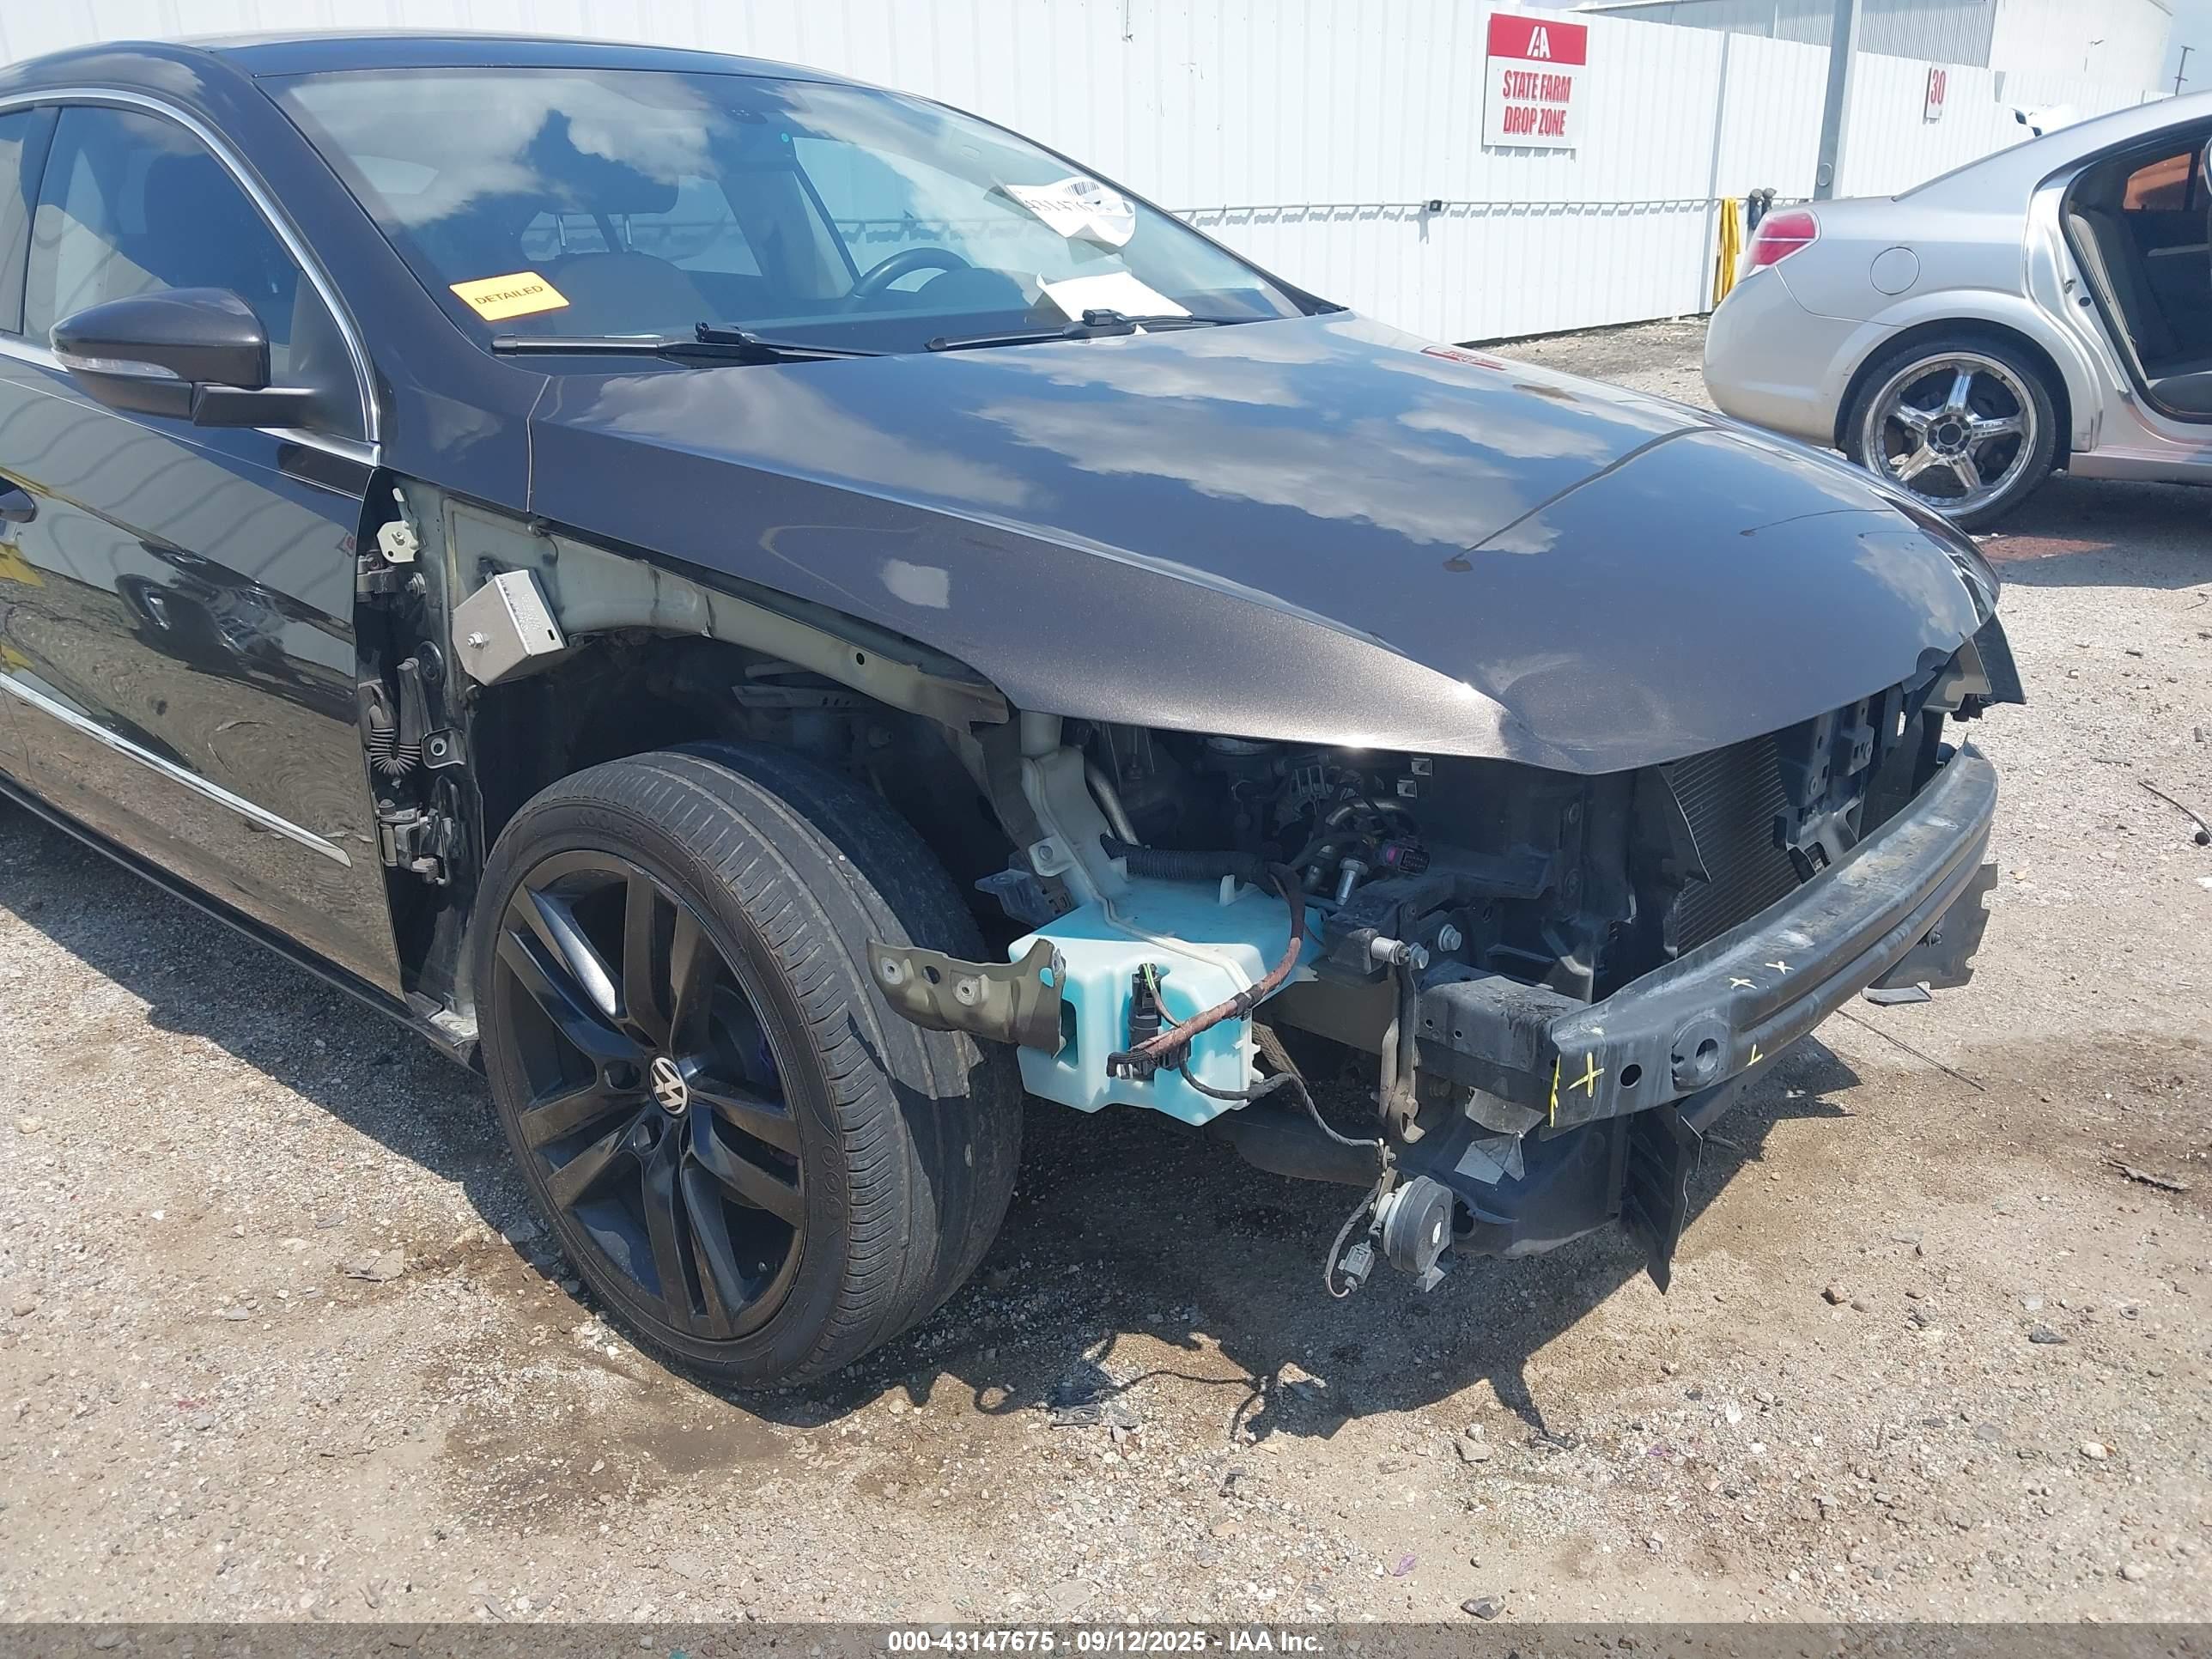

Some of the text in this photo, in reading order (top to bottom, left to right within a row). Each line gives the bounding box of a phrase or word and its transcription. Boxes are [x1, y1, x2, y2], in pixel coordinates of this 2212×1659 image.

[1503, 70, 1572, 103] STATE FARM
[1930, 69, 1946, 105] 30
[1503, 106, 1566, 137] DROP ZONE
[475, 285, 544, 304] DETAILED
